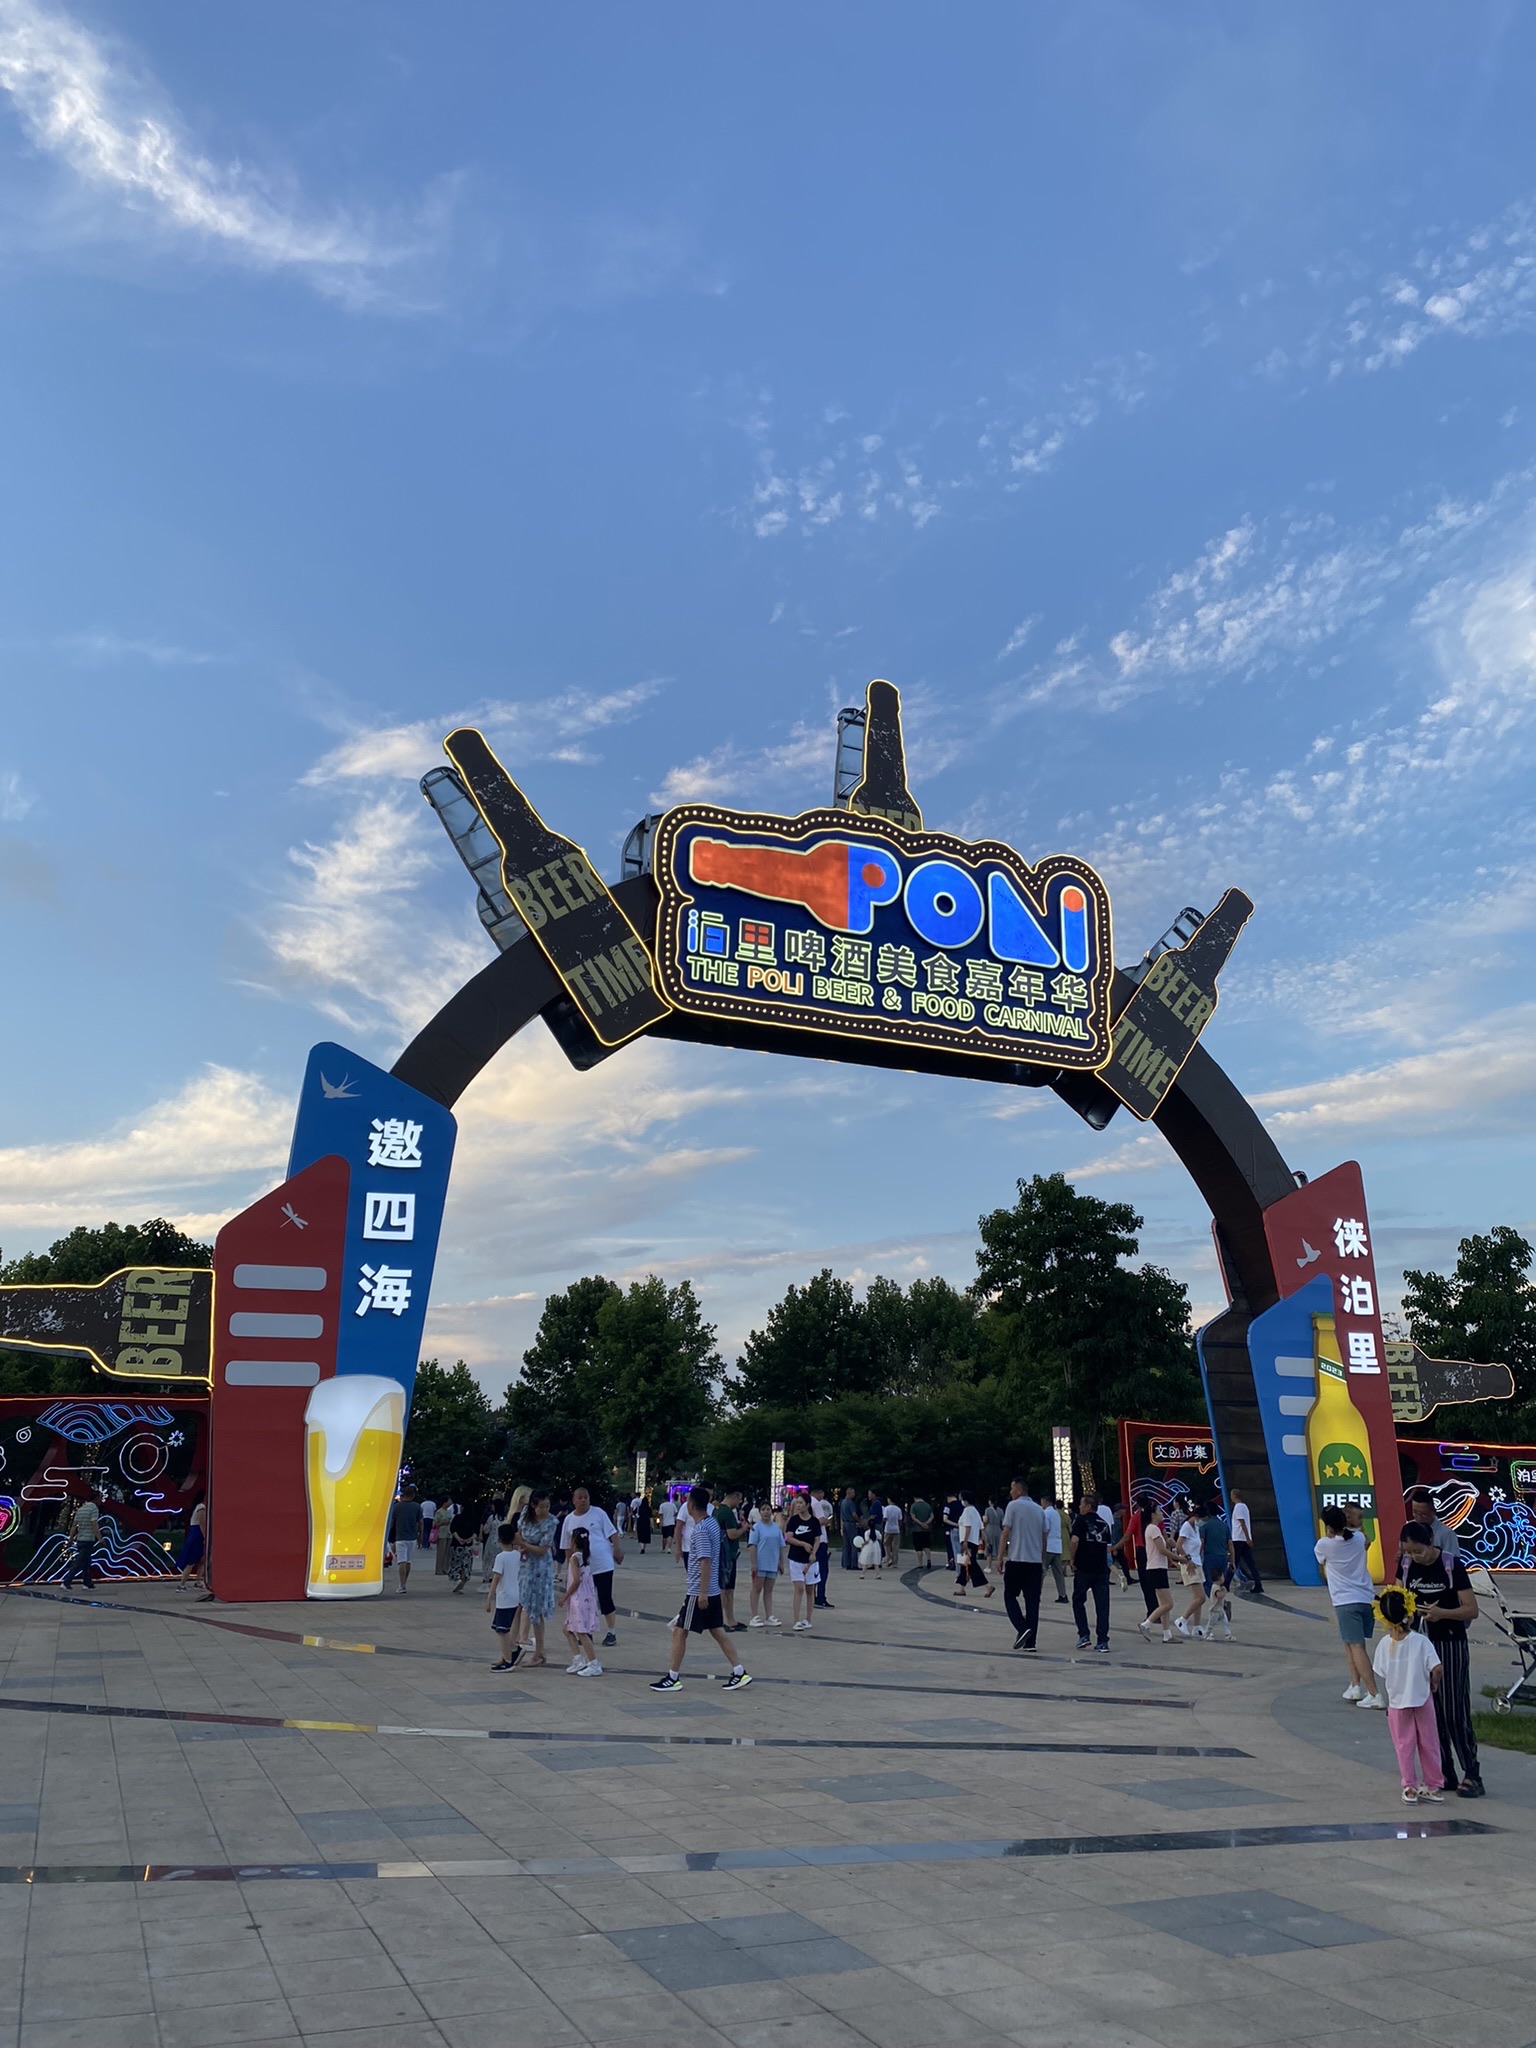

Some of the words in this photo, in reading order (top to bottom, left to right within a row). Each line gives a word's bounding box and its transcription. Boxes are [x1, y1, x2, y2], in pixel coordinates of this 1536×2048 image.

[508, 852, 606, 931] BEER
[687, 955, 739, 986] THE
[747, 965, 803, 995] POLI
[813, 976, 875, 1006] BEER
[882, 987, 902, 1011] &
[911, 991, 975, 1022] FOOD
[983, 1003, 1089, 1040] CARNIVAL
[1145, 954, 1215, 1036] BEER
[1113, 1014, 1179, 1100] TIME
[355, 1118, 424, 1317] 邀四海
[115, 1270, 193, 1375] BEER
[1333, 1217, 1381, 1375] 徕泊里
[1320, 1362, 1343, 1377] 2023
[1384, 1344, 1423, 1420] BEER
[1154, 1444, 1208, 1459] 文创市集
